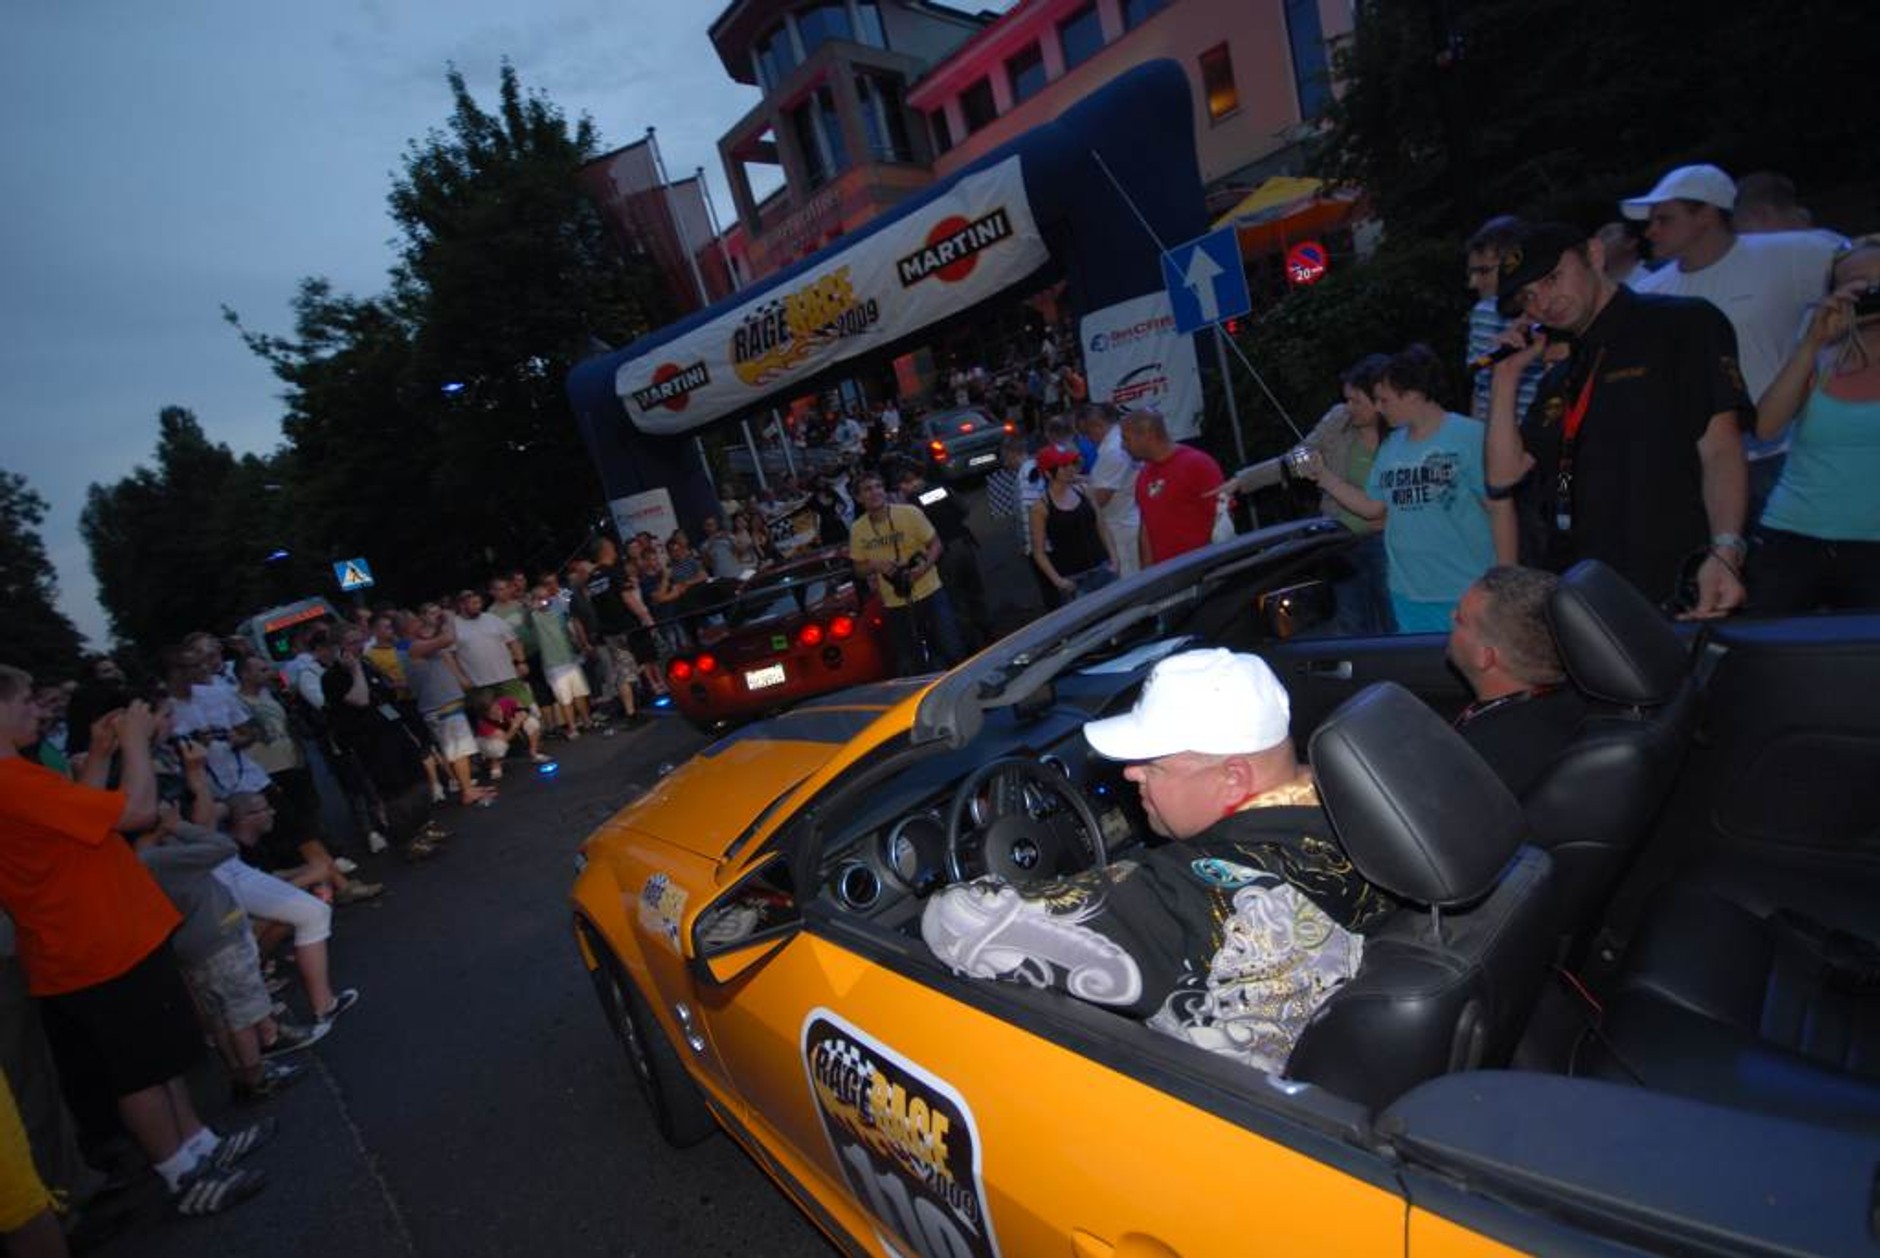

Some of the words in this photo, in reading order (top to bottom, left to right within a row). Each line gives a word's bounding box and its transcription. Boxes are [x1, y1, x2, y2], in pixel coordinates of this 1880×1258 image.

[902, 214, 1006, 281] MARTINI
[734, 308, 790, 363] RAGE
[837, 297, 880, 338] 2009
[635, 366, 706, 407] MARTINI
[815, 1048, 875, 1127] RAGE
[923, 1161, 976, 1219] 2009
